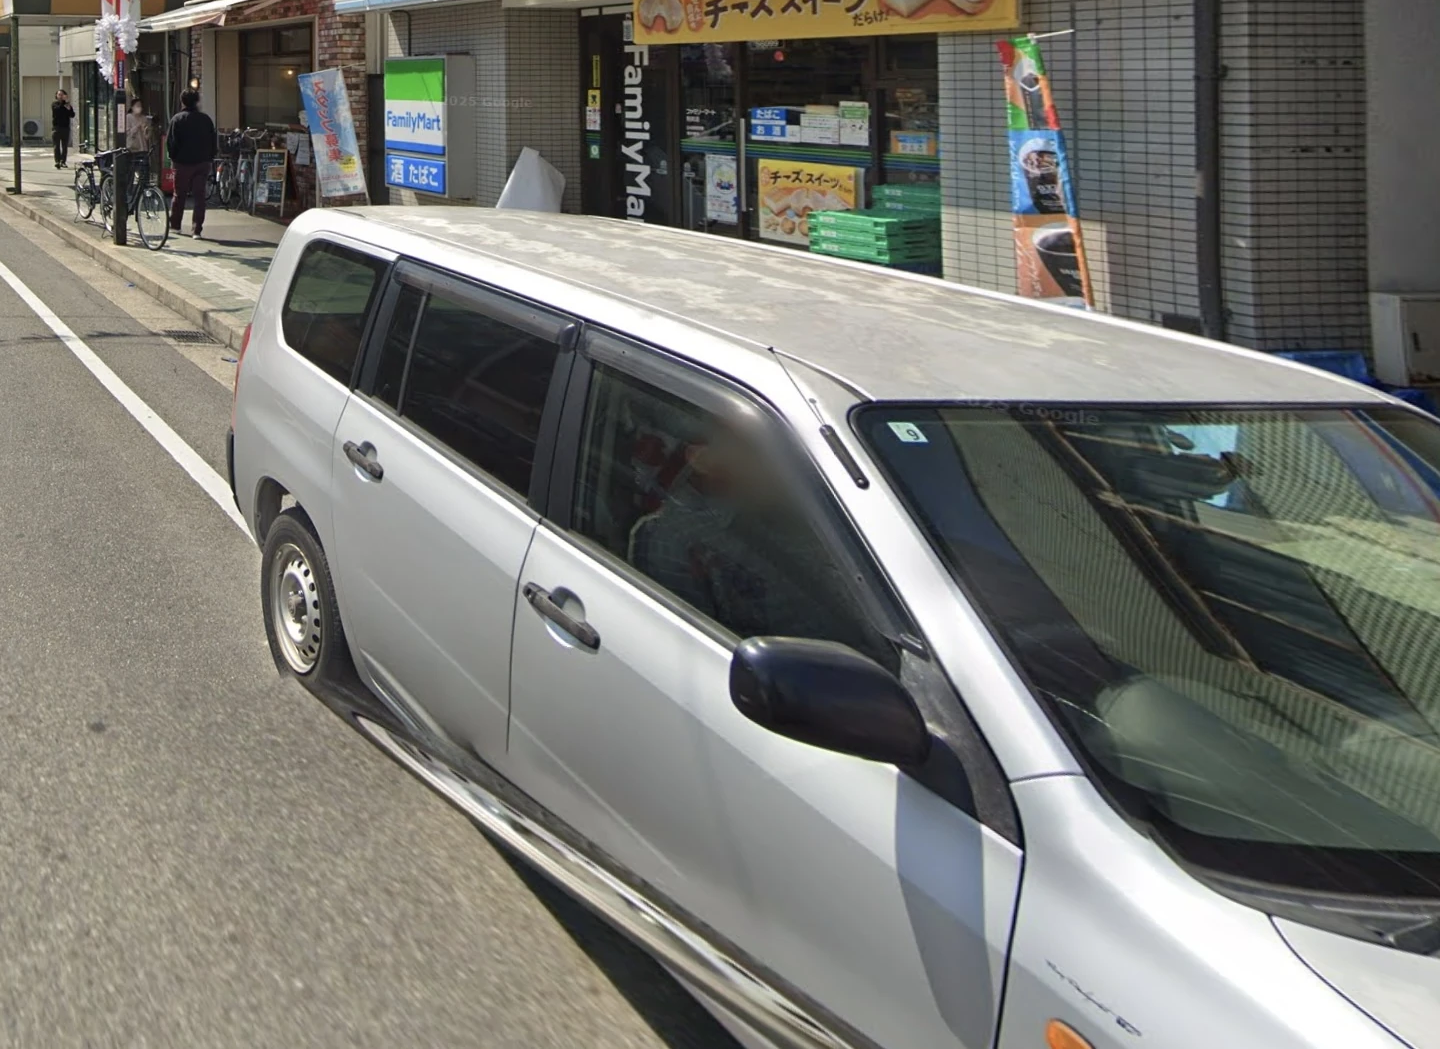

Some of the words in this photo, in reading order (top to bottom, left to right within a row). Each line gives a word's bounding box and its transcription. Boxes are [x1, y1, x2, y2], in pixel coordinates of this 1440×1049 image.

[386, 110, 441, 133] FamilyMart
[755, 109, 780, 120] たばこ
[391, 158, 404, 184] 酒
[409, 164, 439, 186] たばこ
